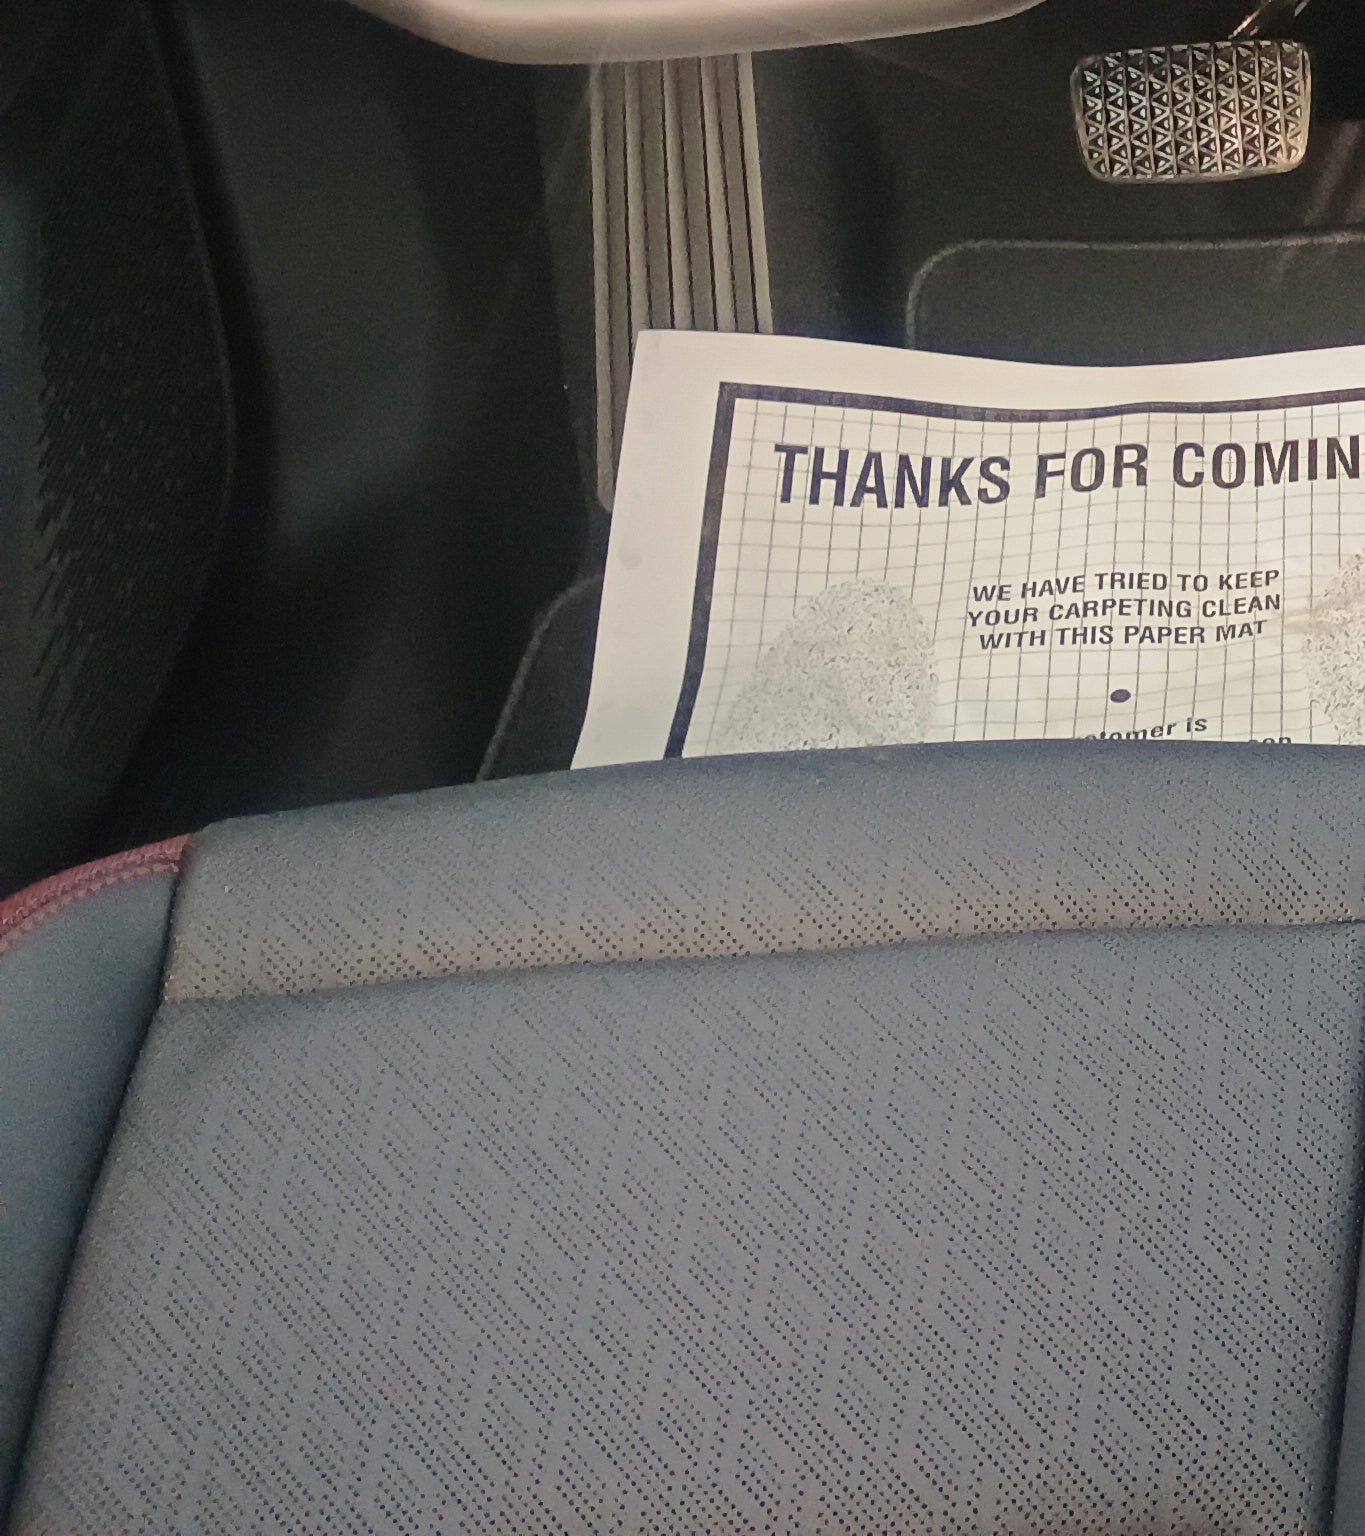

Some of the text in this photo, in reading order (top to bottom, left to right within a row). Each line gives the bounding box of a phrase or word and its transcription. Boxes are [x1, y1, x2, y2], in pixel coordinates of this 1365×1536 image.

[774, 442, 1012, 509] THANKS
[1035, 443, 1148, 500] FOR
[972, 569, 1280, 602] WE HAVE TRIED TO KEEP
[967, 594, 1281, 627] YOUR CARPETING CLEAN
[979, 620, 1268, 650] WITH THIS PAPER MAT
[1186, 717, 1207, 732] is
